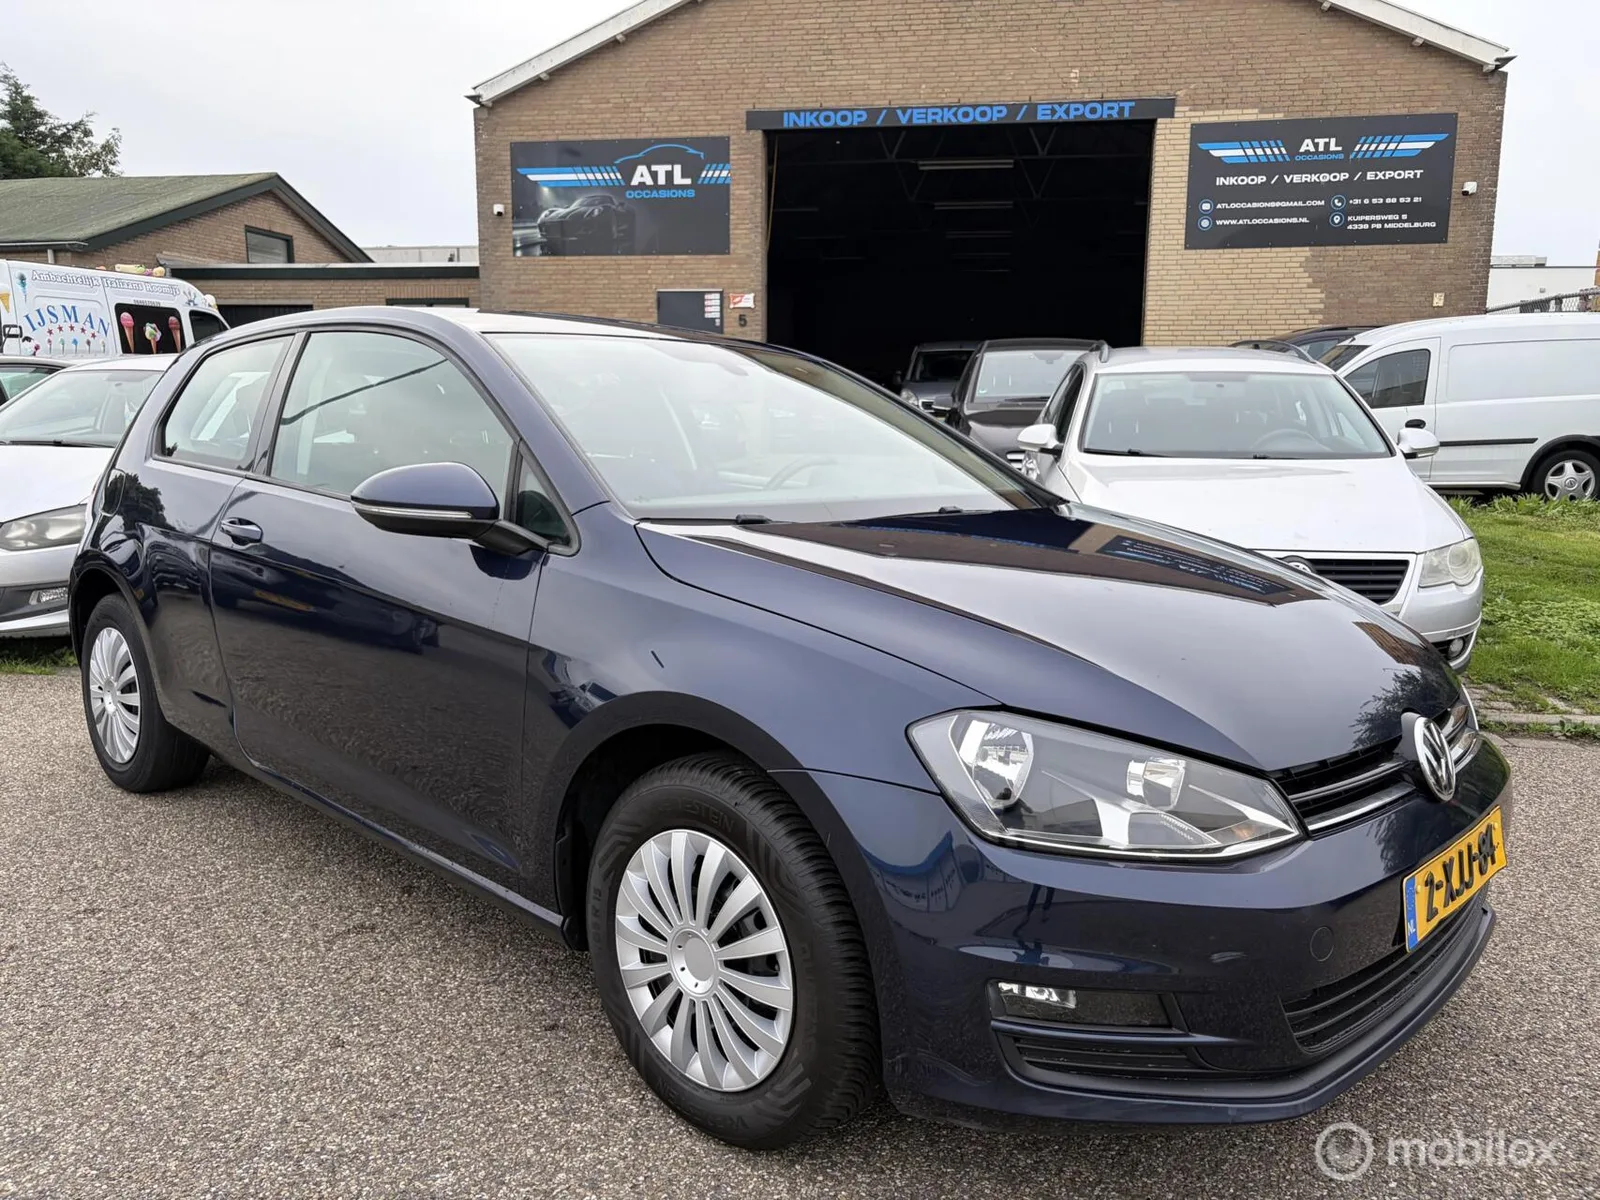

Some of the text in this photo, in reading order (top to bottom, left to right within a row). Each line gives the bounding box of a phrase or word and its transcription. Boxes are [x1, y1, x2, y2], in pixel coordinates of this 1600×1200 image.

[783, 101, 1136, 129] INKOOP / VERKOOP / EXPORT
[1299, 137, 1343, 153] ATL
[1294, 153, 1345, 162] OCCASIONS
[630, 164, 692, 186] ATL
[1216, 169, 1424, 186] INKOOP / VERKOOP / EXPORT
[625, 189, 695, 199] OCCASIONS
[1216, 217, 1310, 226] WWW.ATLOCCASIONS.NL
[1347, 213, 1400, 222] KUIPERSWEG
[1384, 221, 1437, 229] MIDDELBURG
[31, 270, 101, 288] Ambachtelijk
[23, 304, 110, 338] IJSMAN
[738, 314, 748, 328] 5
